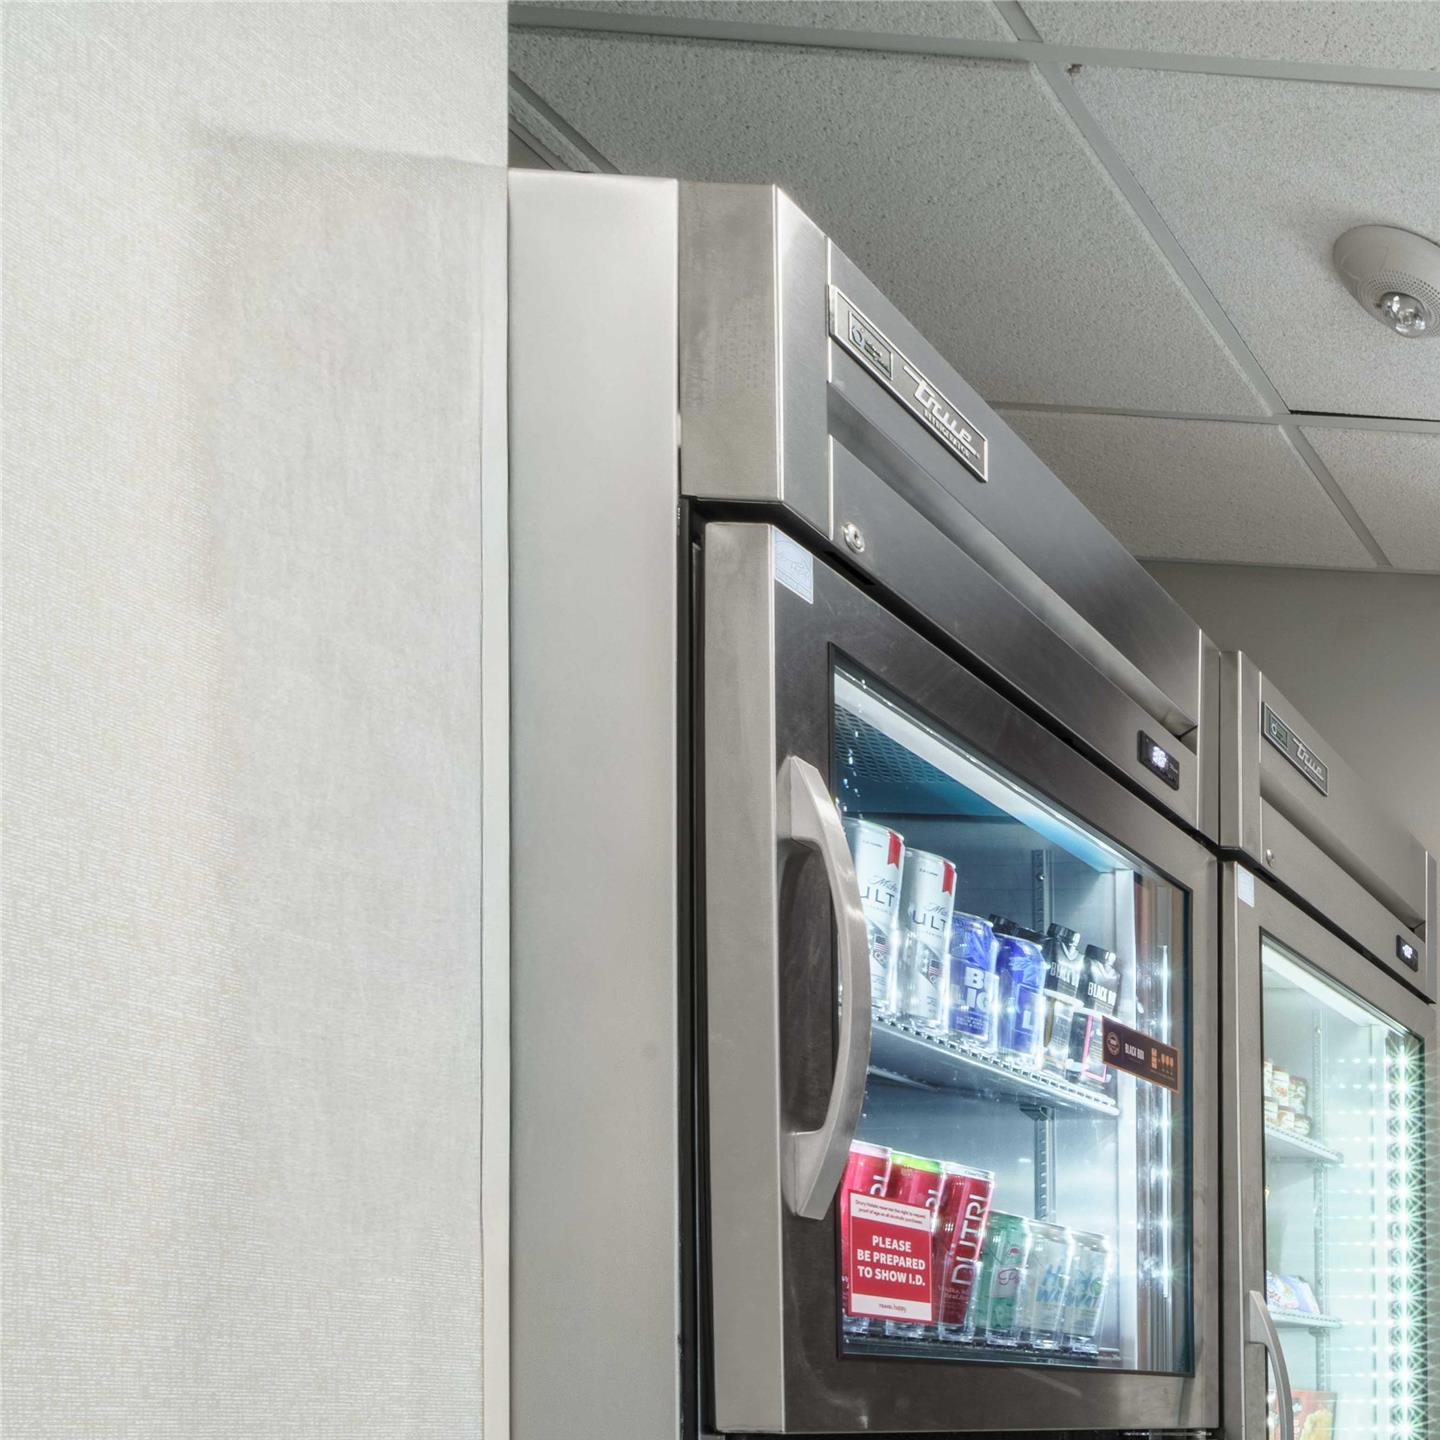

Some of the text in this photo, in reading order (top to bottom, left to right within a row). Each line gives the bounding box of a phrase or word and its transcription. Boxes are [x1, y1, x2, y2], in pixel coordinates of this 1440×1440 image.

[1088, 982, 1107, 1002] BLACK
[1125, 1042, 1136, 1058] BLACK
[872, 1235, 912, 1253] PLEASE
[857, 1249, 926, 1270] BE PREPARED
[857, 1265, 926, 1286] TO SHOW I.D.
